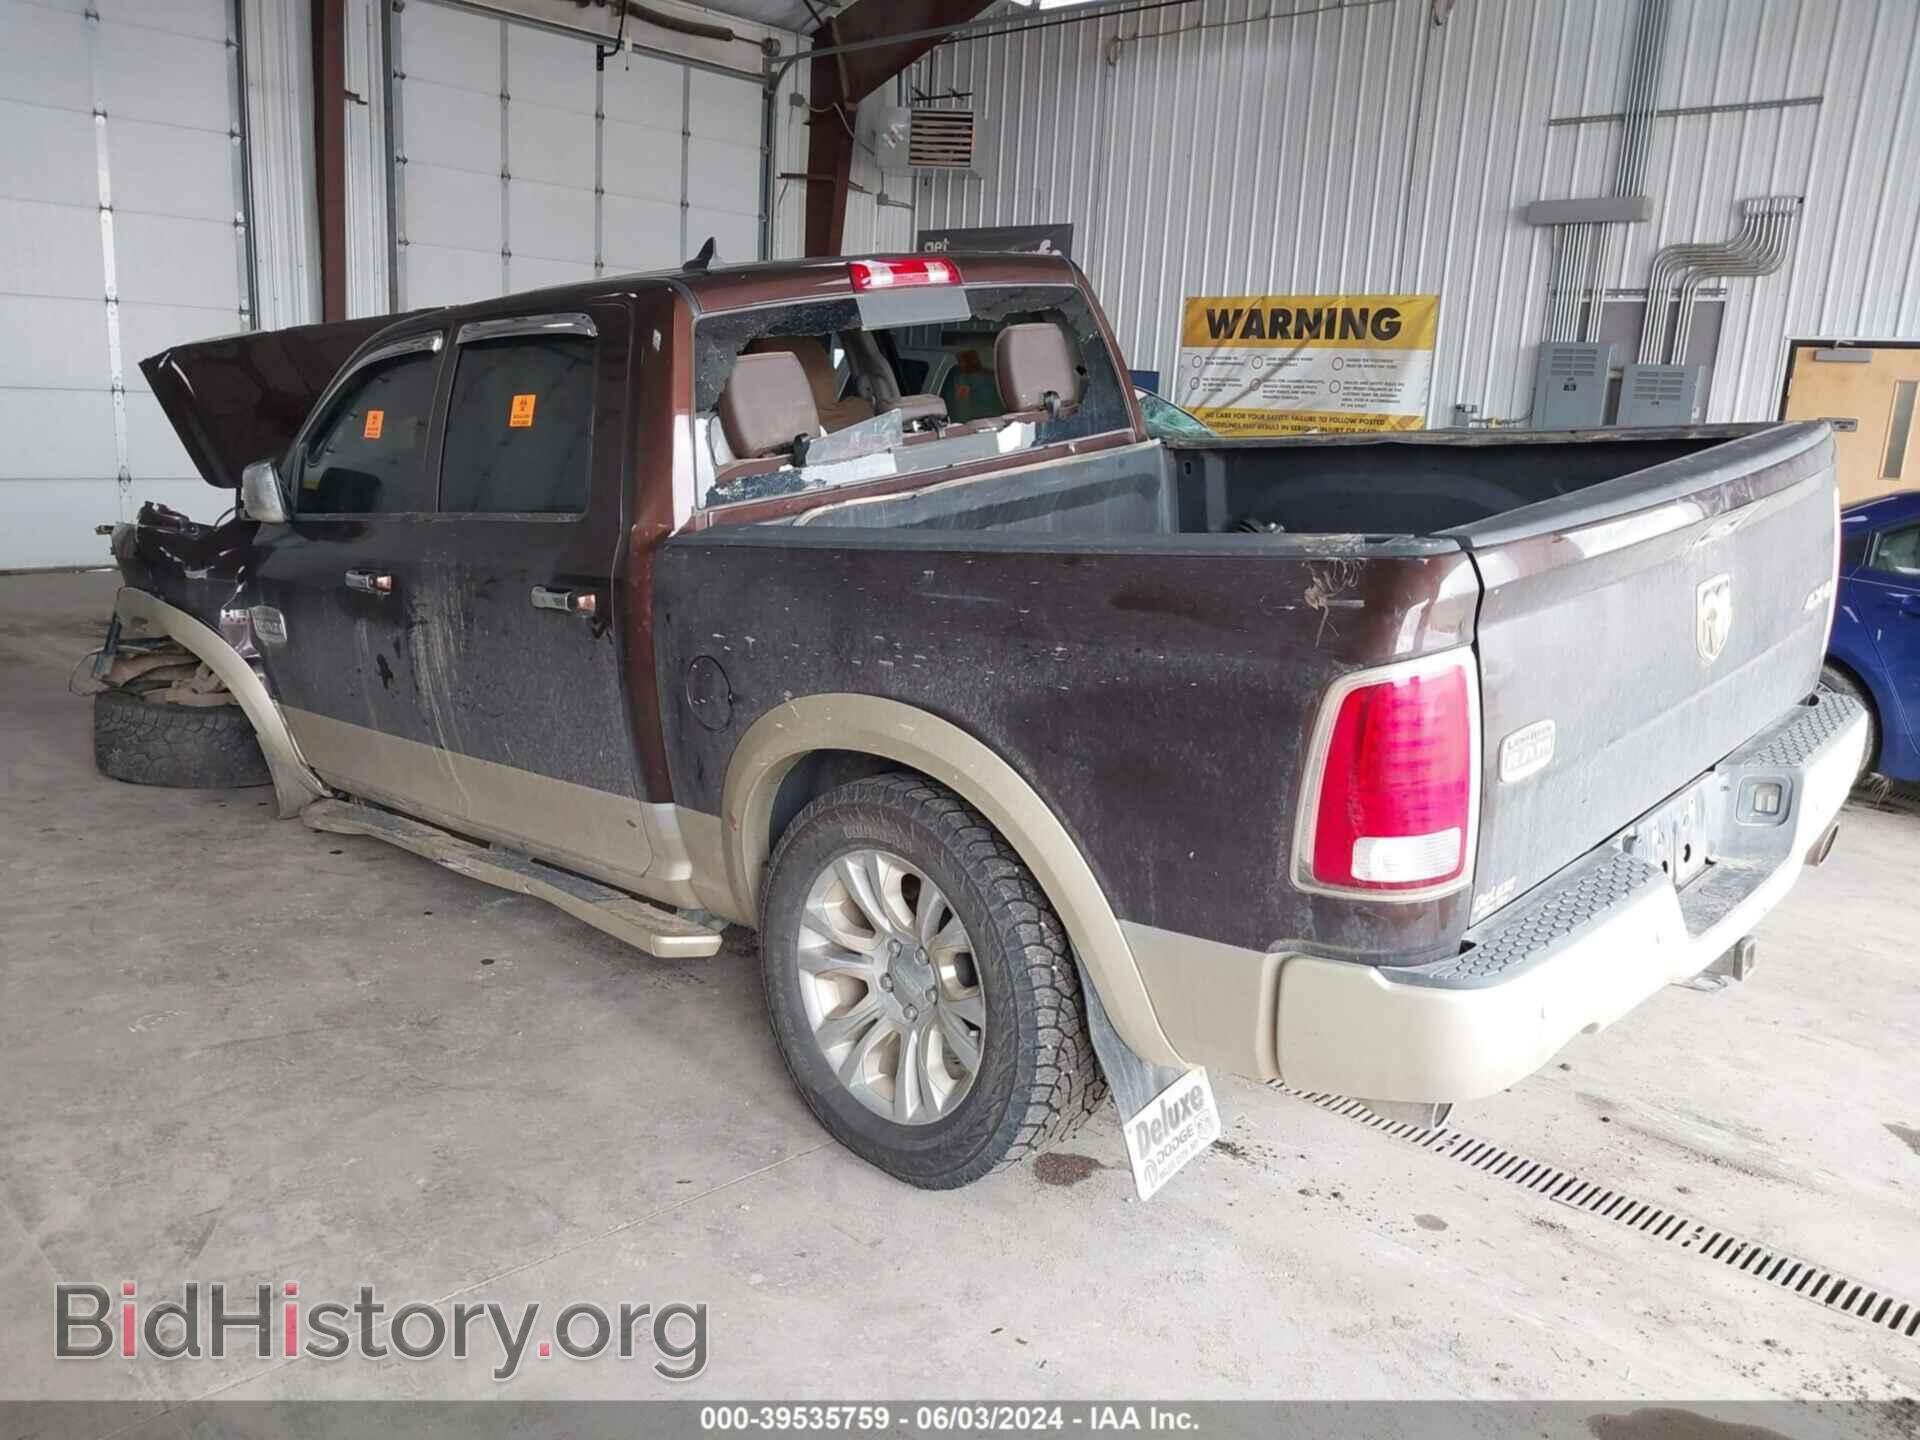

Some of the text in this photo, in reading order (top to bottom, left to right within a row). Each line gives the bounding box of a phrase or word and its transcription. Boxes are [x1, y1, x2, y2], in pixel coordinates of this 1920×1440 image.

[1206, 307, 1402, 341] WARNING
[1248, 413, 1266, 421] YOUR
[1291, 414, 1317, 423] FAILURE
[1320, 415, 1328, 423] TO
[1329, 415, 1358, 425] FOLLOW
[1359, 417, 1386, 426] POSTED
[1136, 1085, 1204, 1159] Deluxe
